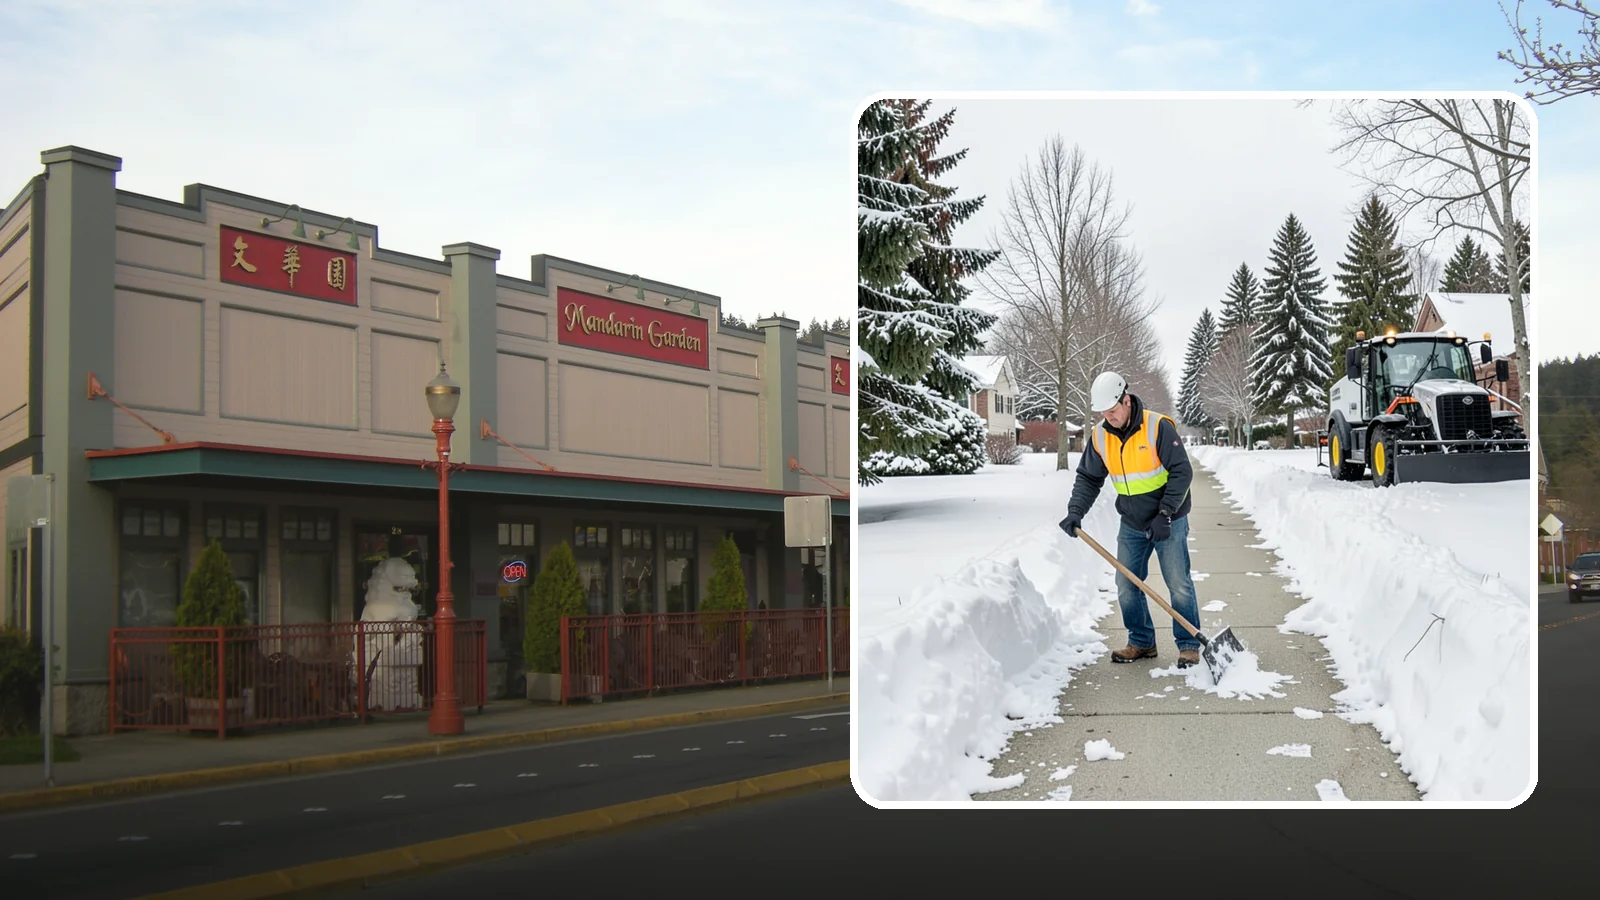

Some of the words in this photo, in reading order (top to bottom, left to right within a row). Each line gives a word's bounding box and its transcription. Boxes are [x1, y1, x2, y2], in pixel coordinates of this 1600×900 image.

[231, 235, 346, 291] 文華園
[565, 302, 644, 341] Mandarin
[648, 320, 701, 352] Garden
[503, 565, 527, 578] OPEN
